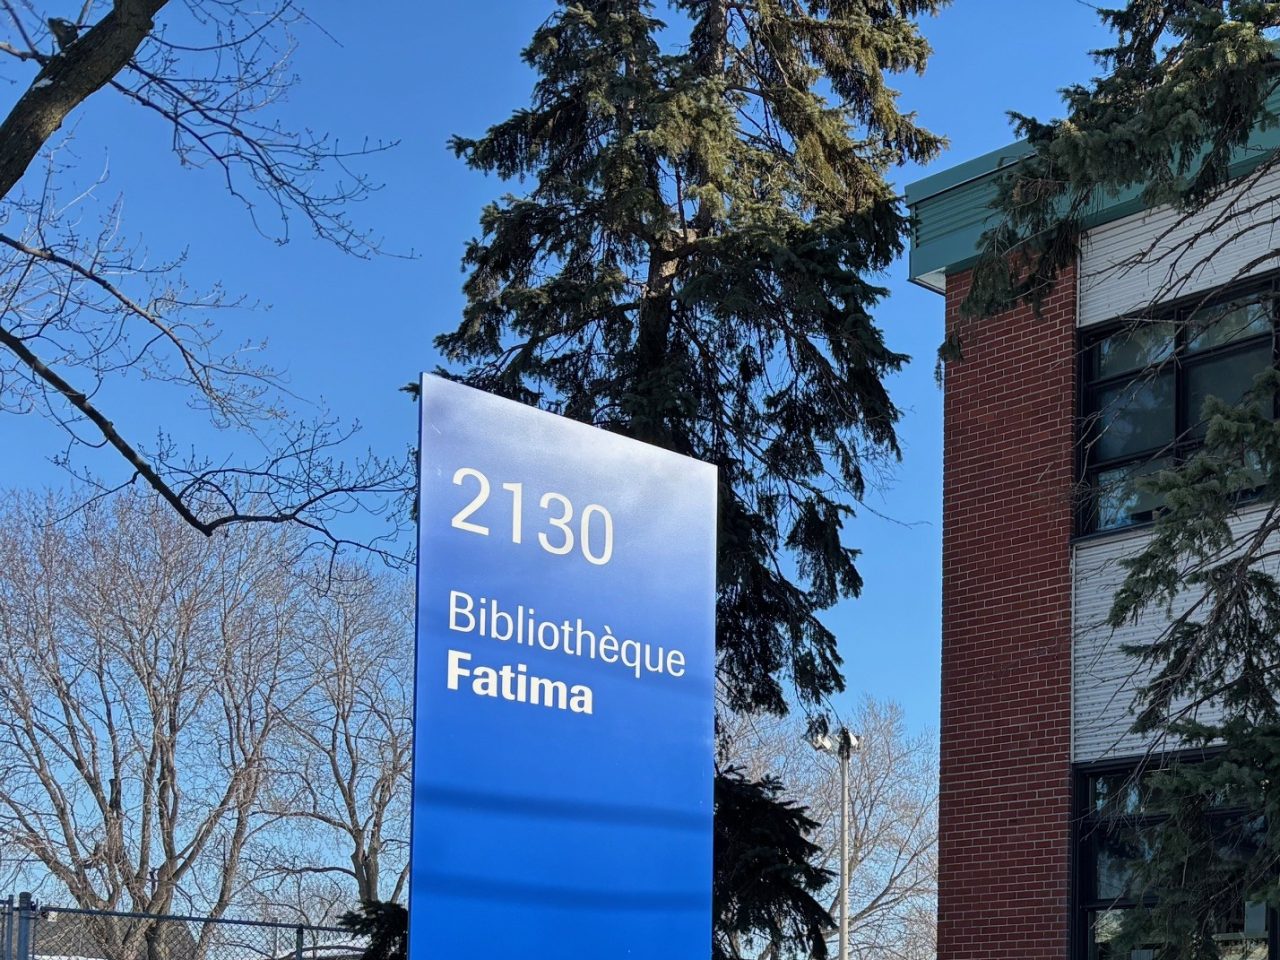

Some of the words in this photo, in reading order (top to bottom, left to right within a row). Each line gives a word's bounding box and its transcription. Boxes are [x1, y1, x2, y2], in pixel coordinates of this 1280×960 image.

[451, 467, 614, 566] 2130
[449, 590, 686, 679] Bibliothèque
[447, 650, 593, 715] Fatima
